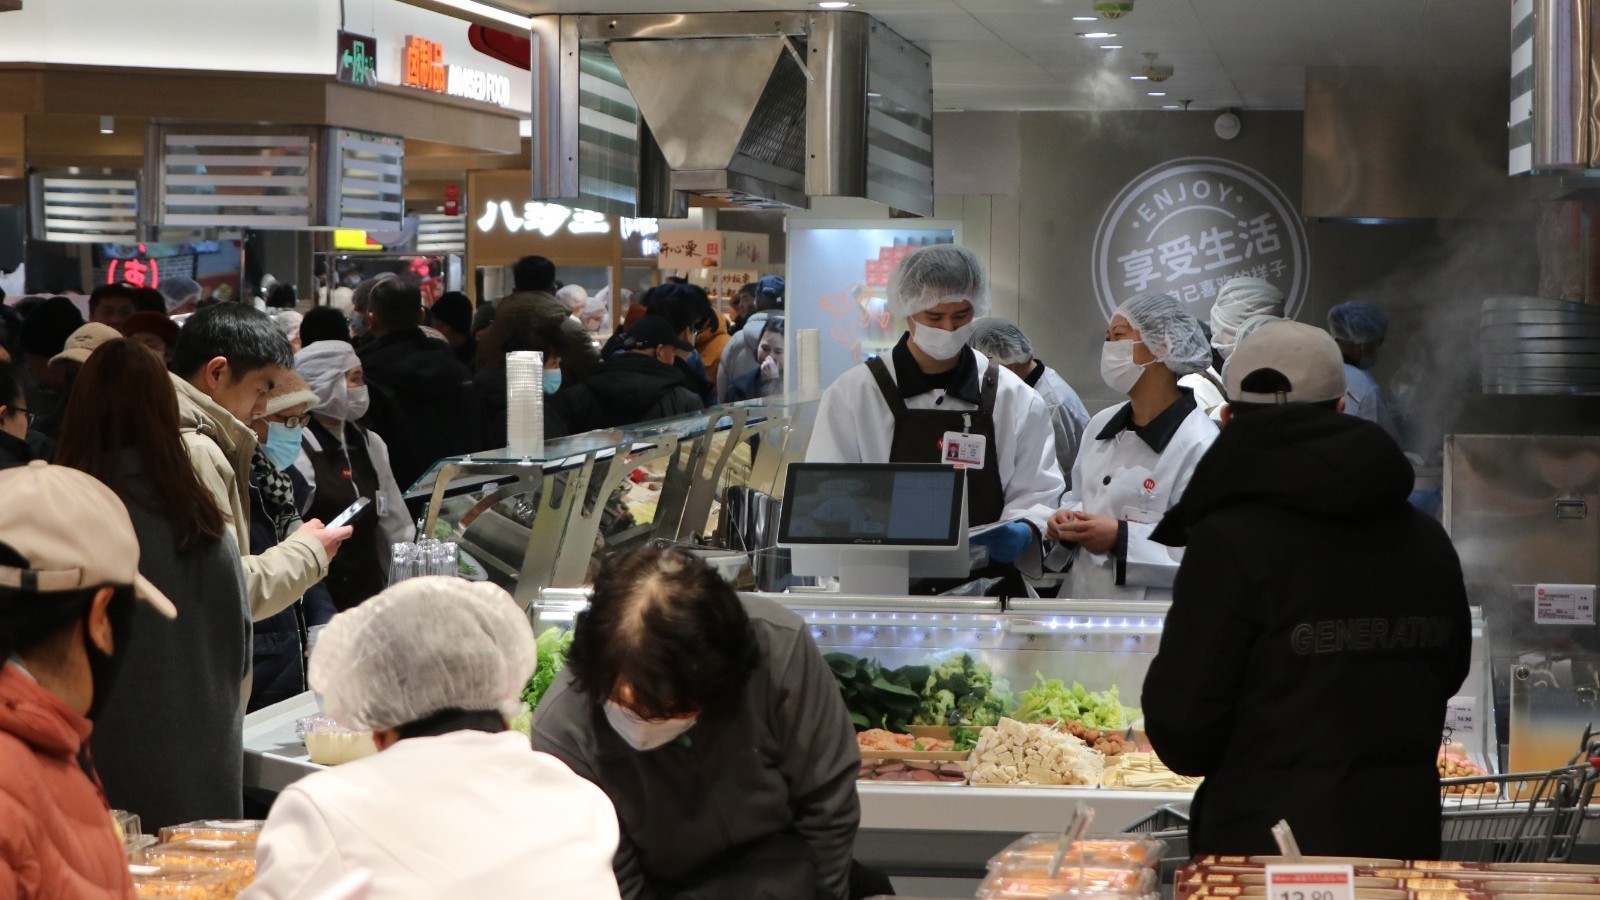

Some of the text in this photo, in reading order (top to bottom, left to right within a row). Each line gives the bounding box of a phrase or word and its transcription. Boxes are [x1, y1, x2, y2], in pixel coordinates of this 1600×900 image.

[407, 36, 443, 92] 卤制品
[486, 73, 511, 105] FOOD
[1137, 180, 1233, 222] ENJOY
[1118, 213, 1281, 291] 享受生活
